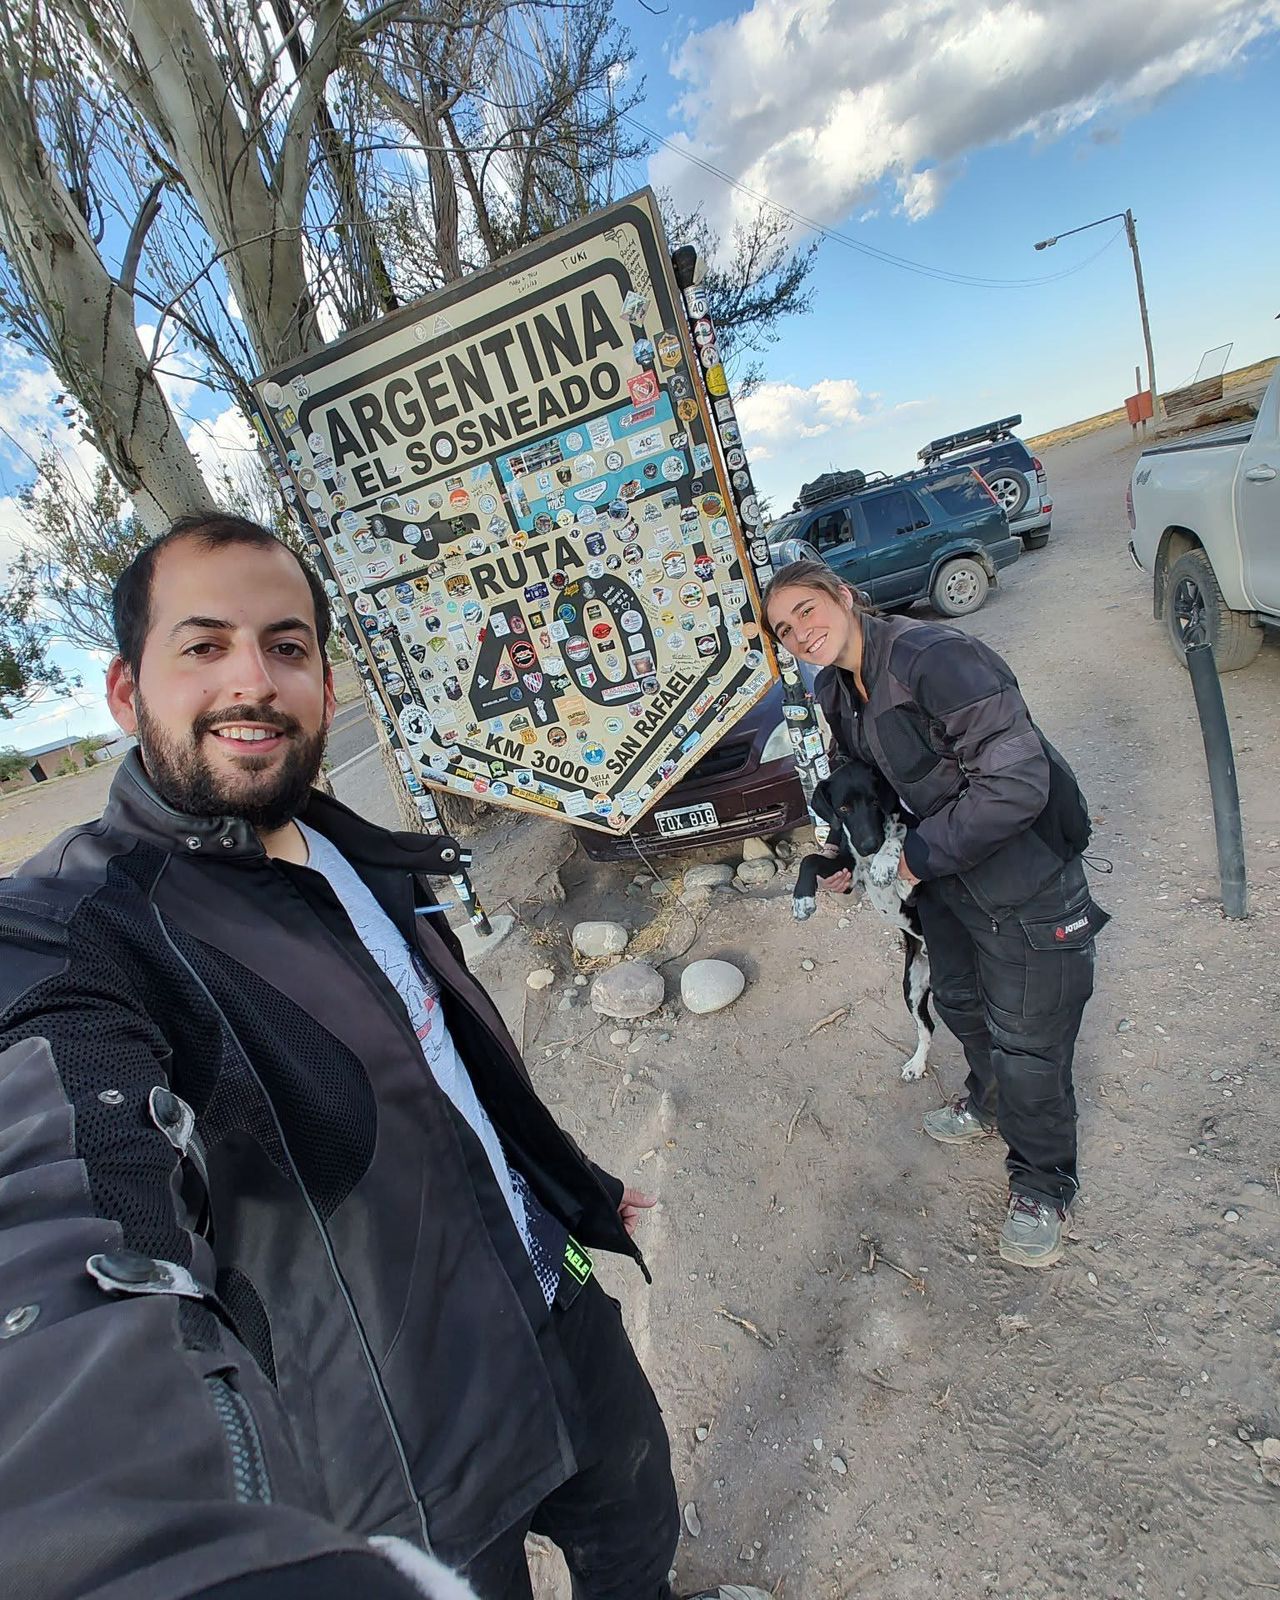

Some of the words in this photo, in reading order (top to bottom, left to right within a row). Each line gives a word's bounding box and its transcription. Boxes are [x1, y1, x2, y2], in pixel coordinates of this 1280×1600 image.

[693, 300, 705, 314] 40
[666, 350, 676, 359] 40
[325, 290, 623, 467] ARGENTINA
[297, 388, 308, 398] 40
[351, 457, 402, 498] EL
[406, 361, 621, 476] SOSNEADO
[470, 535, 584, 600] RUTA
[728, 595, 741, 606] 40
[468, 572, 658, 729] 40
[605, 735, 642, 775] SAN
[633, 671, 696, 739] RAFAEL
[485, 732, 525, 762] KM
[530, 749, 590, 784] 3000
[590, 773, 611, 783] BELLA
[594, 780, 610, 788] VITA
[689, 809, 715, 827] 818
[565, 1244, 590, 1277] AELE
